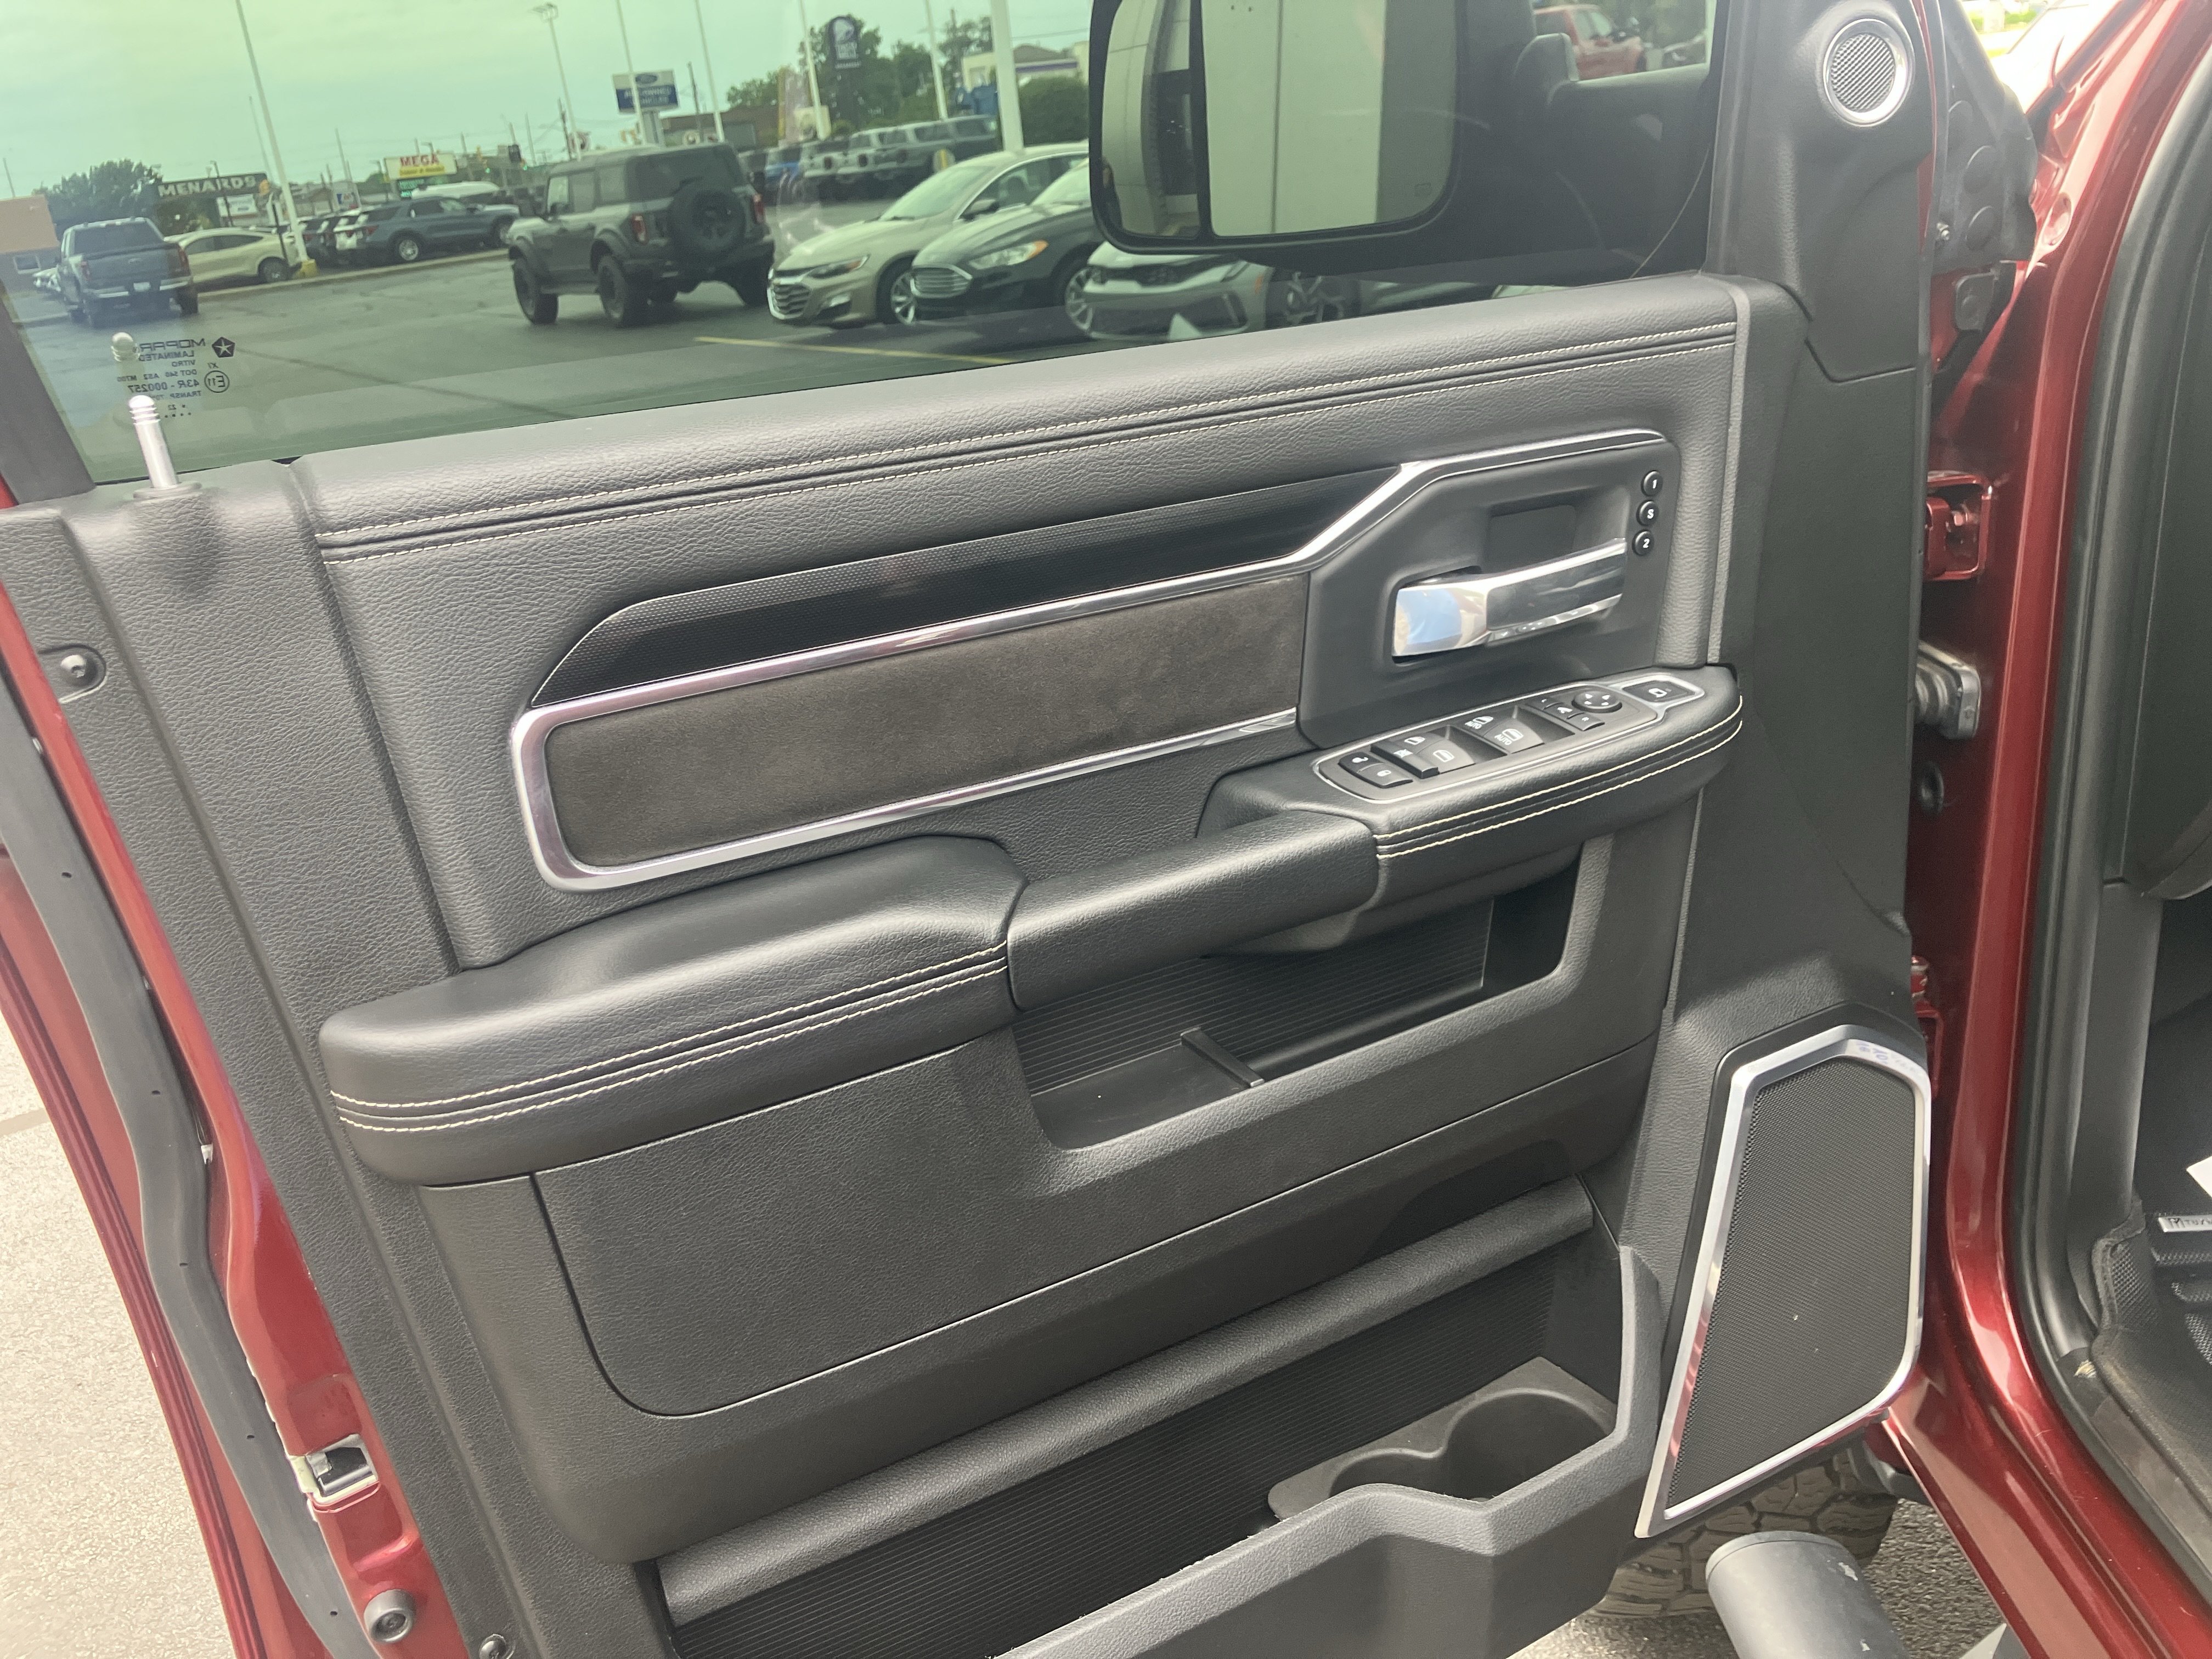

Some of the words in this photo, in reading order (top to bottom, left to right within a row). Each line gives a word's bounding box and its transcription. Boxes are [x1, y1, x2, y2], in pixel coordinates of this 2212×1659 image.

[399, 154, 439, 166] MEGA
[158, 176, 256, 196] MENARDS
[1652, 479, 1657, 489] 1
[1647, 509, 1654, 519] S
[1643, 538, 1650, 549] 2
[1464, 720, 1482, 730] AUTO
[1494, 733, 1513, 746] AUTO
